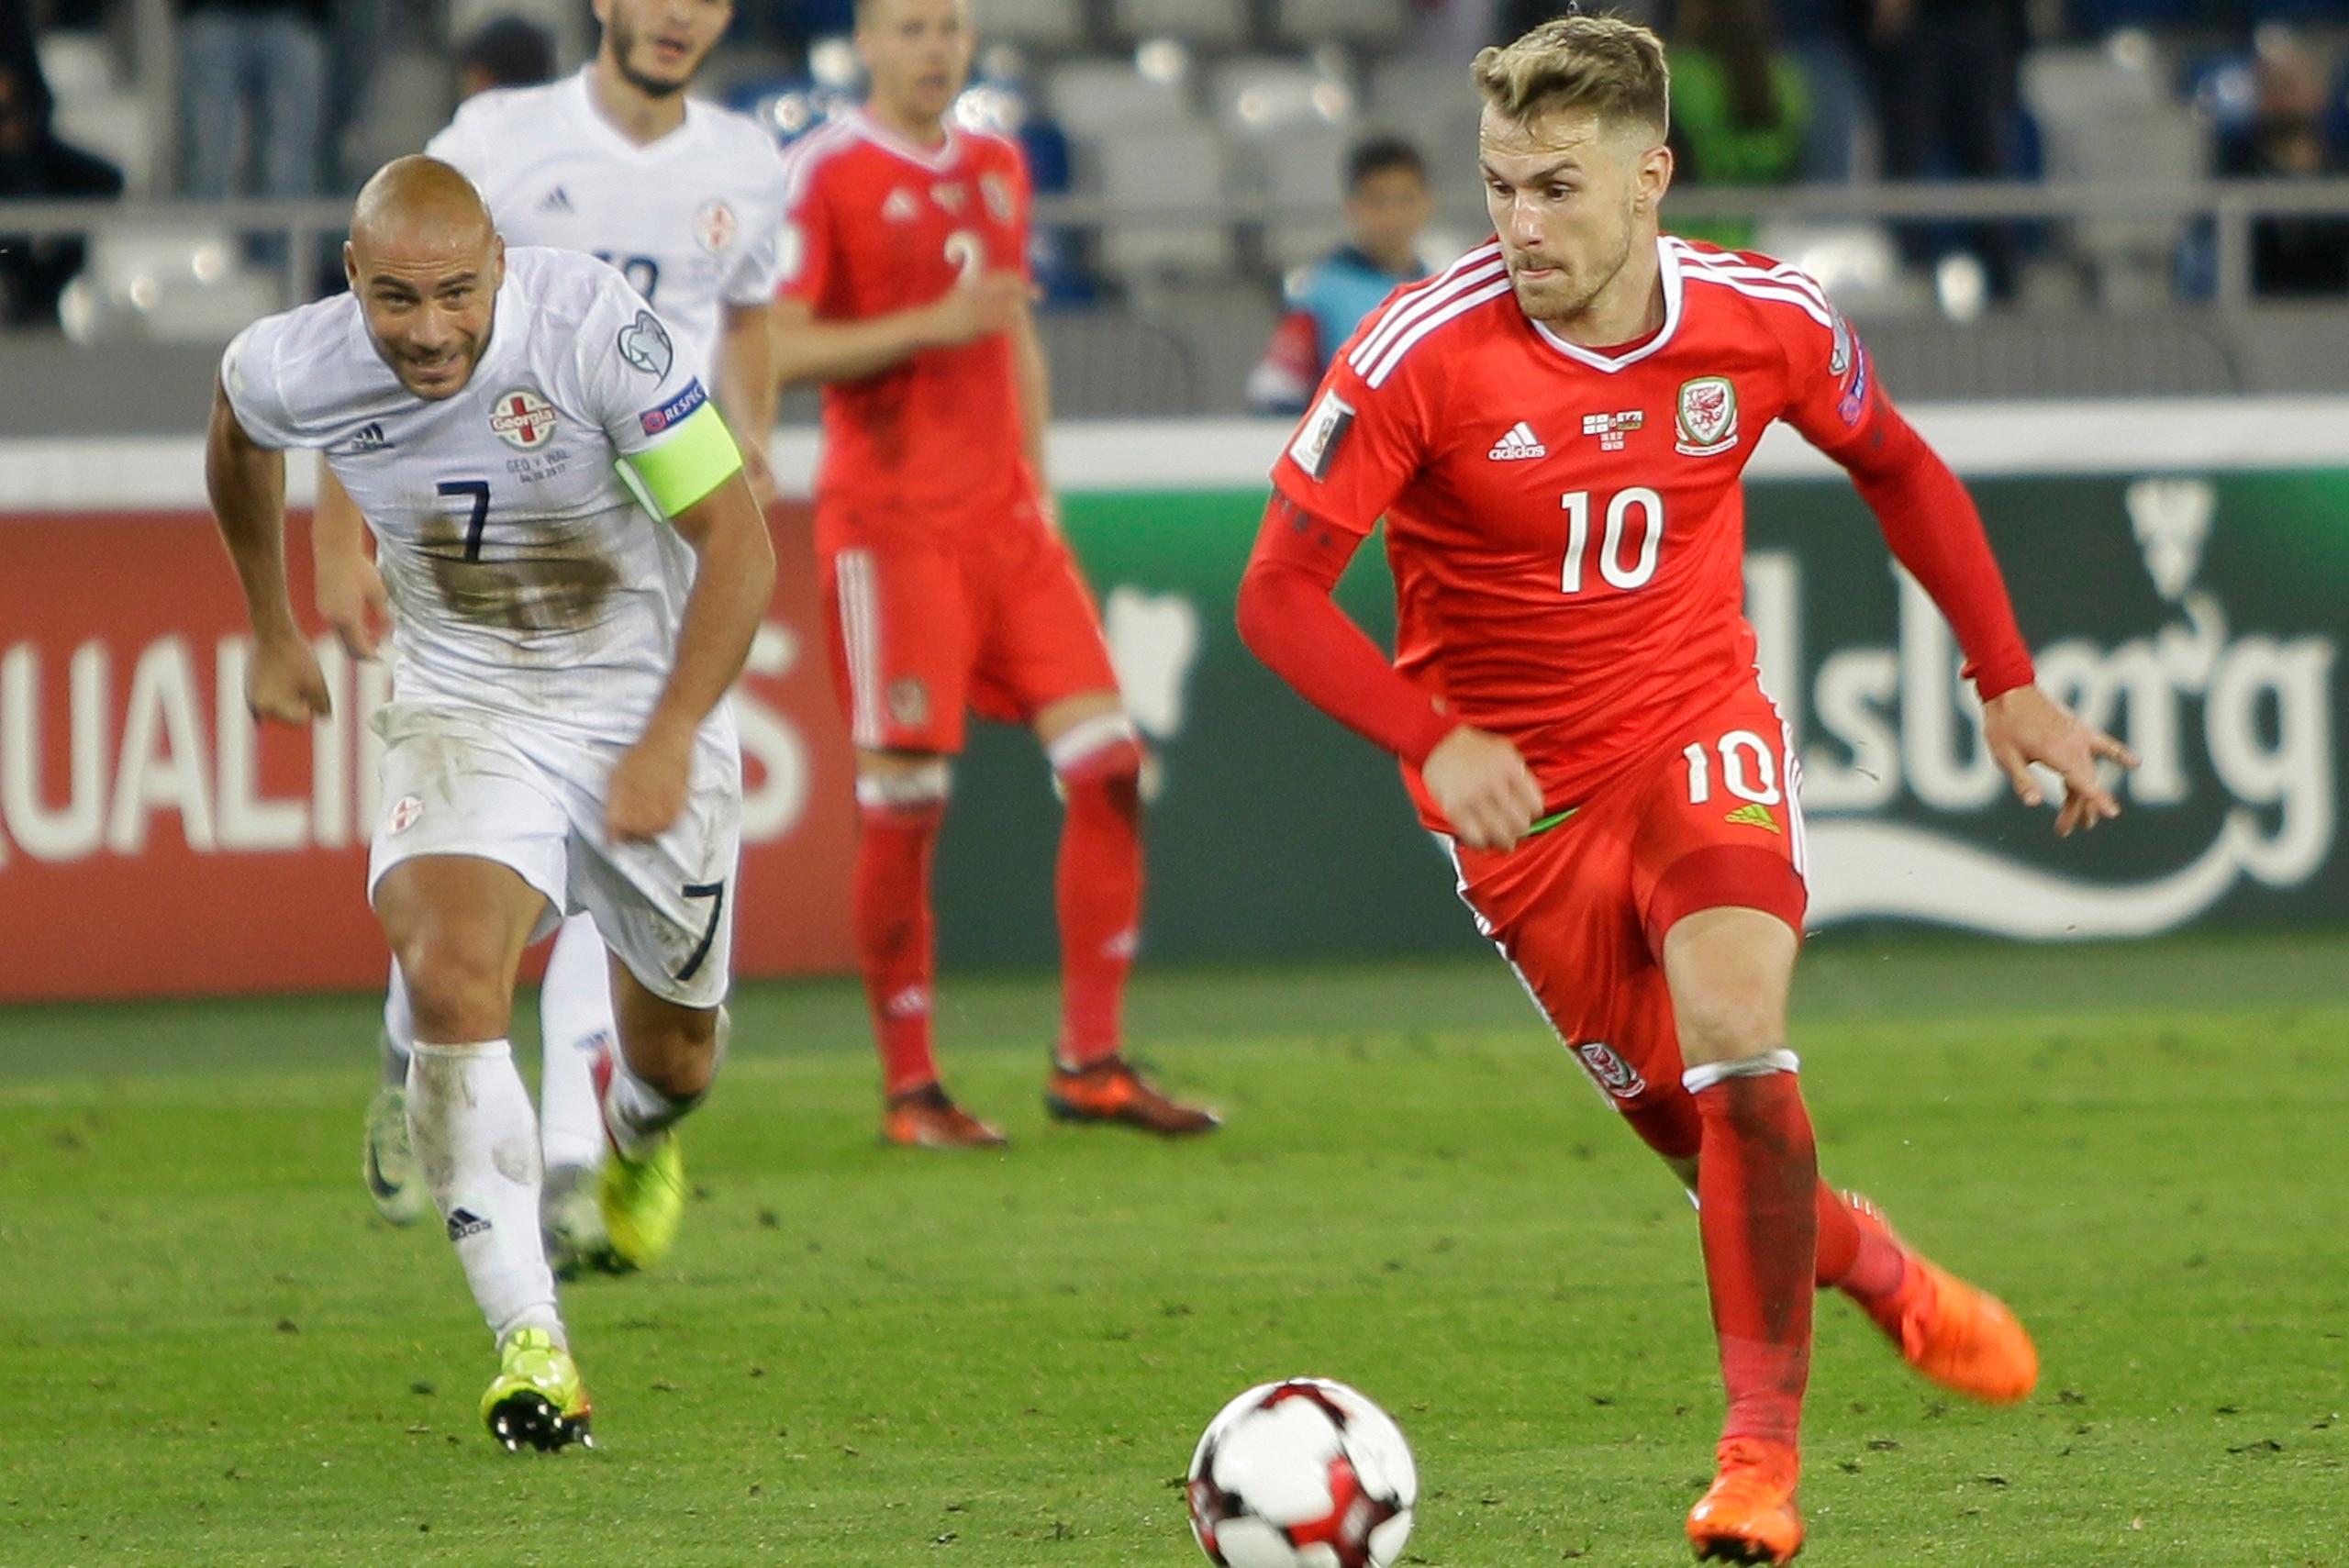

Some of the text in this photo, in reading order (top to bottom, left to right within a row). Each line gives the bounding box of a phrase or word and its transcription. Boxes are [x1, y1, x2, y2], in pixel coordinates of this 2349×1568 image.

[493, 408, 554, 430] Georgia
[1488, 444, 1546, 461] adidas
[437, 480, 490, 562] 7
[1561, 485, 1664, 595] 10
[1683, 728, 1782, 806] 10
[676, 879, 723, 981] 7
